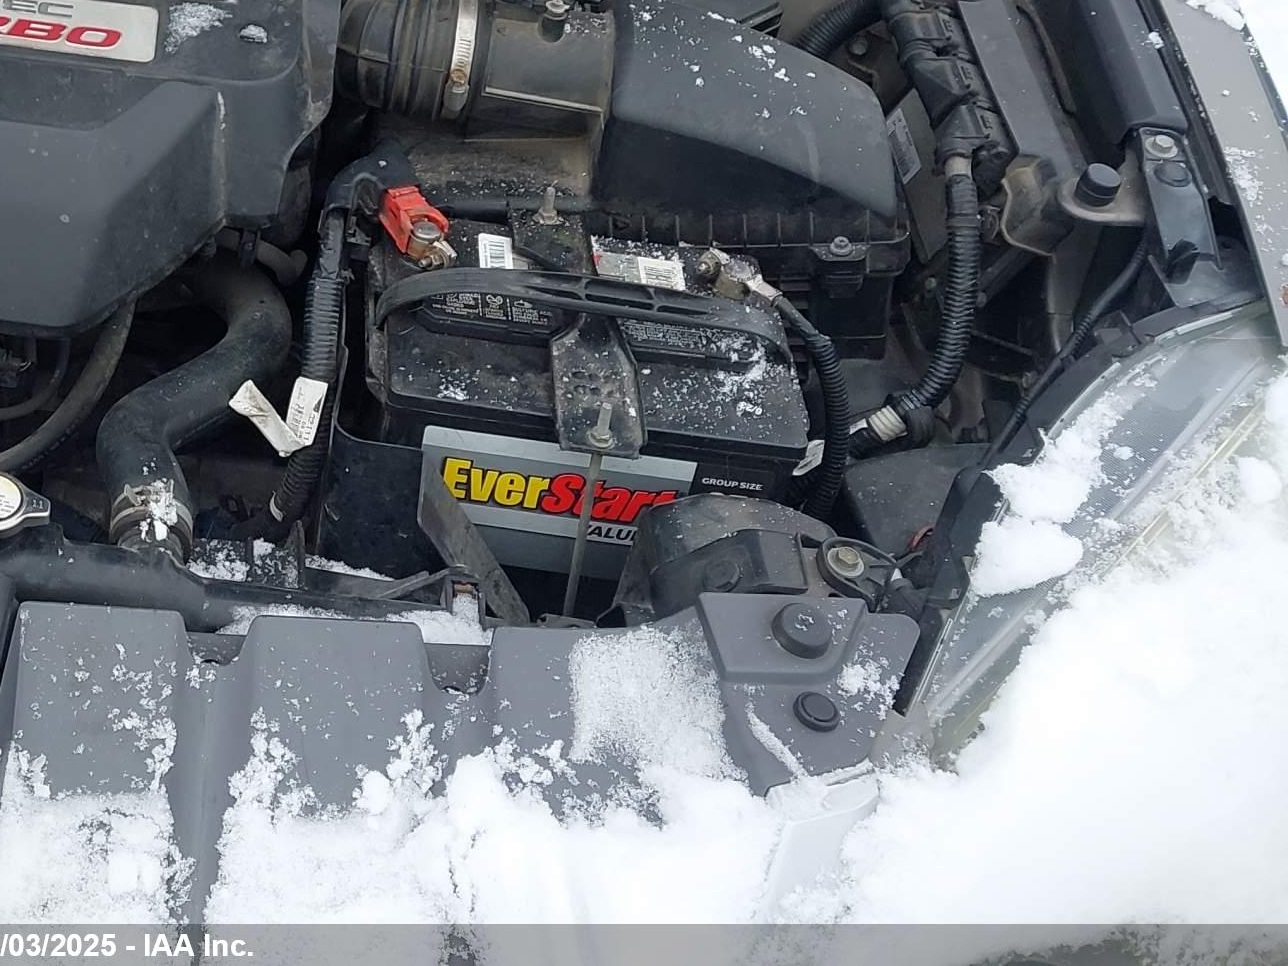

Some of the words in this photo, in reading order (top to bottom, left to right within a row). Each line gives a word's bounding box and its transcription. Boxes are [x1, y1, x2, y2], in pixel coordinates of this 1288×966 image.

[701, 477, 739, 488] GROUP
[739, 482, 764, 491] SIZE
[585, 524, 637, 541] ALU
